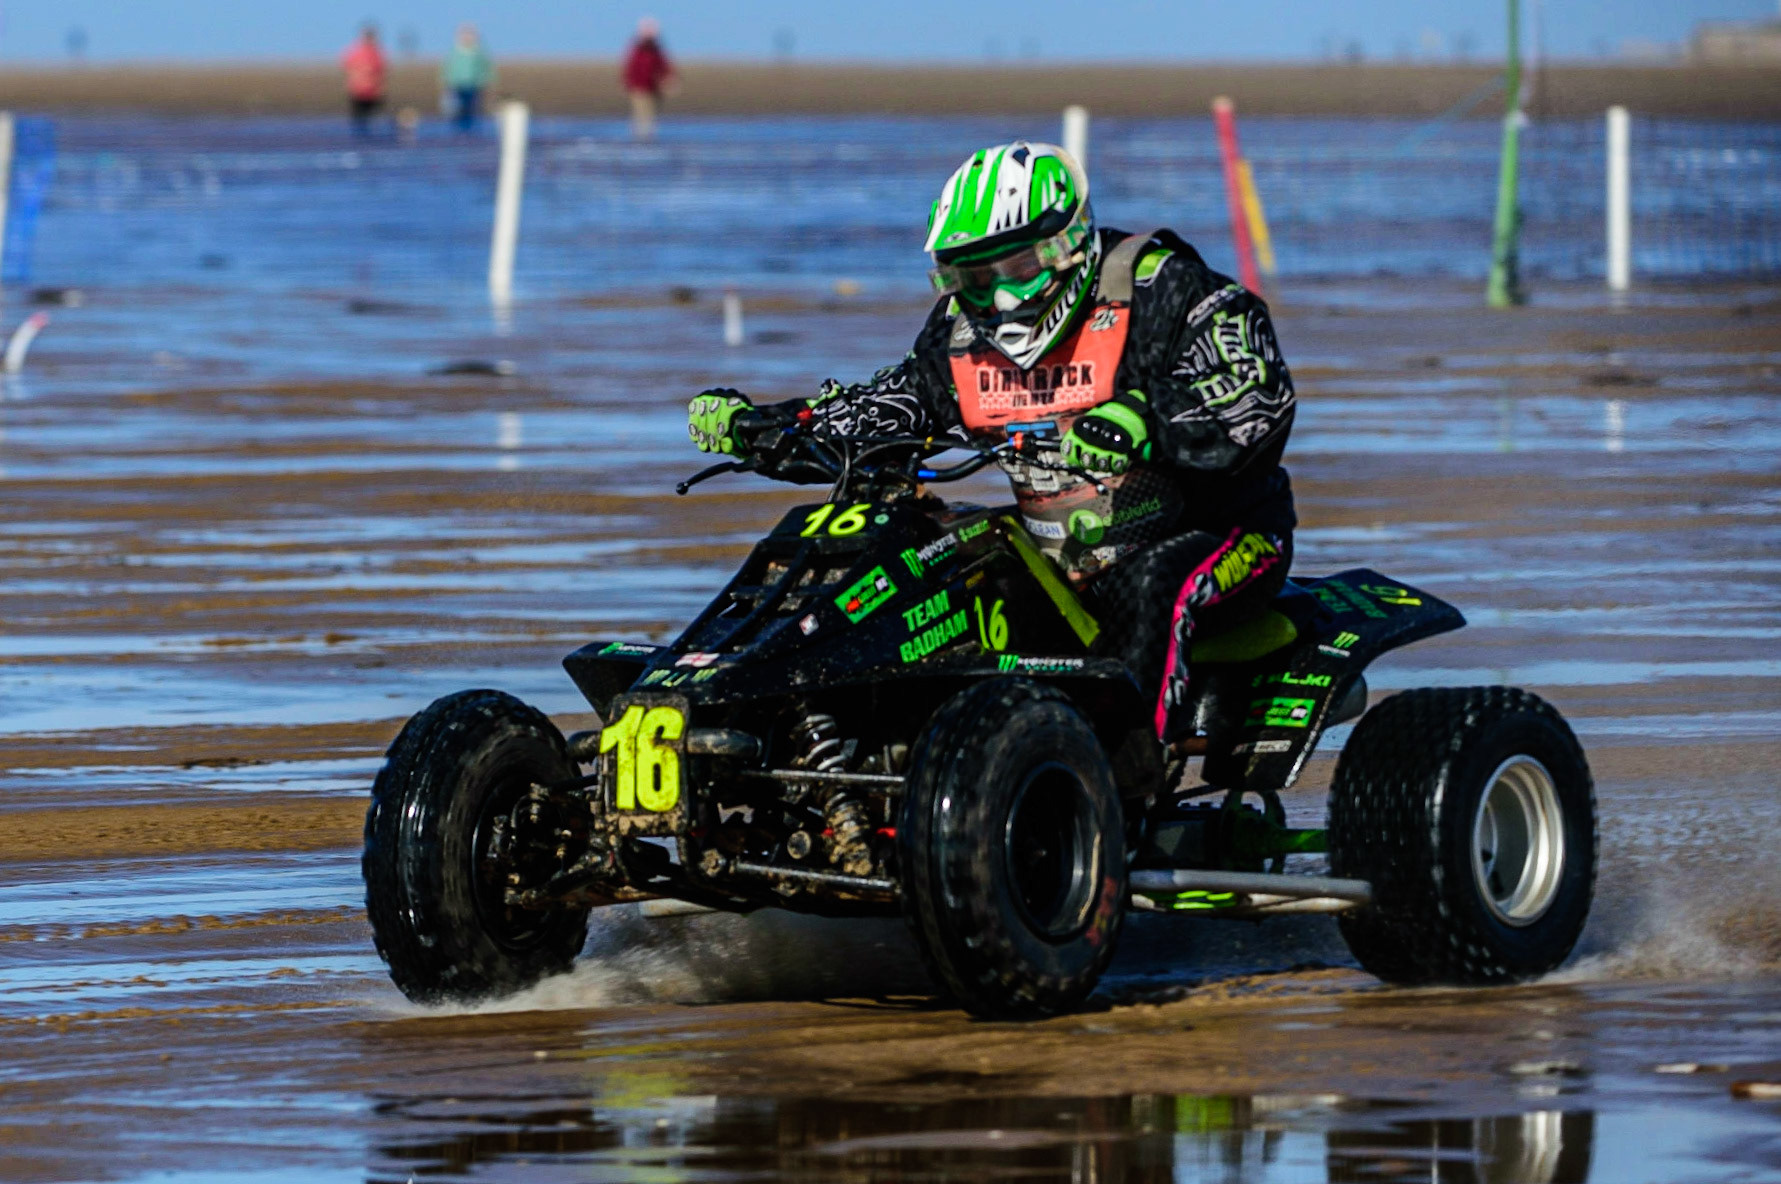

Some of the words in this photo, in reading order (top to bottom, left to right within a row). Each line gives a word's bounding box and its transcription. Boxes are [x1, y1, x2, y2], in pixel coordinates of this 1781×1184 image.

[800, 503, 871, 538] 16
[900, 608, 969, 664] BADHAM
[902, 589, 950, 633] TEAM
[973, 595, 1009, 652] 16
[600, 704, 685, 812] 16
